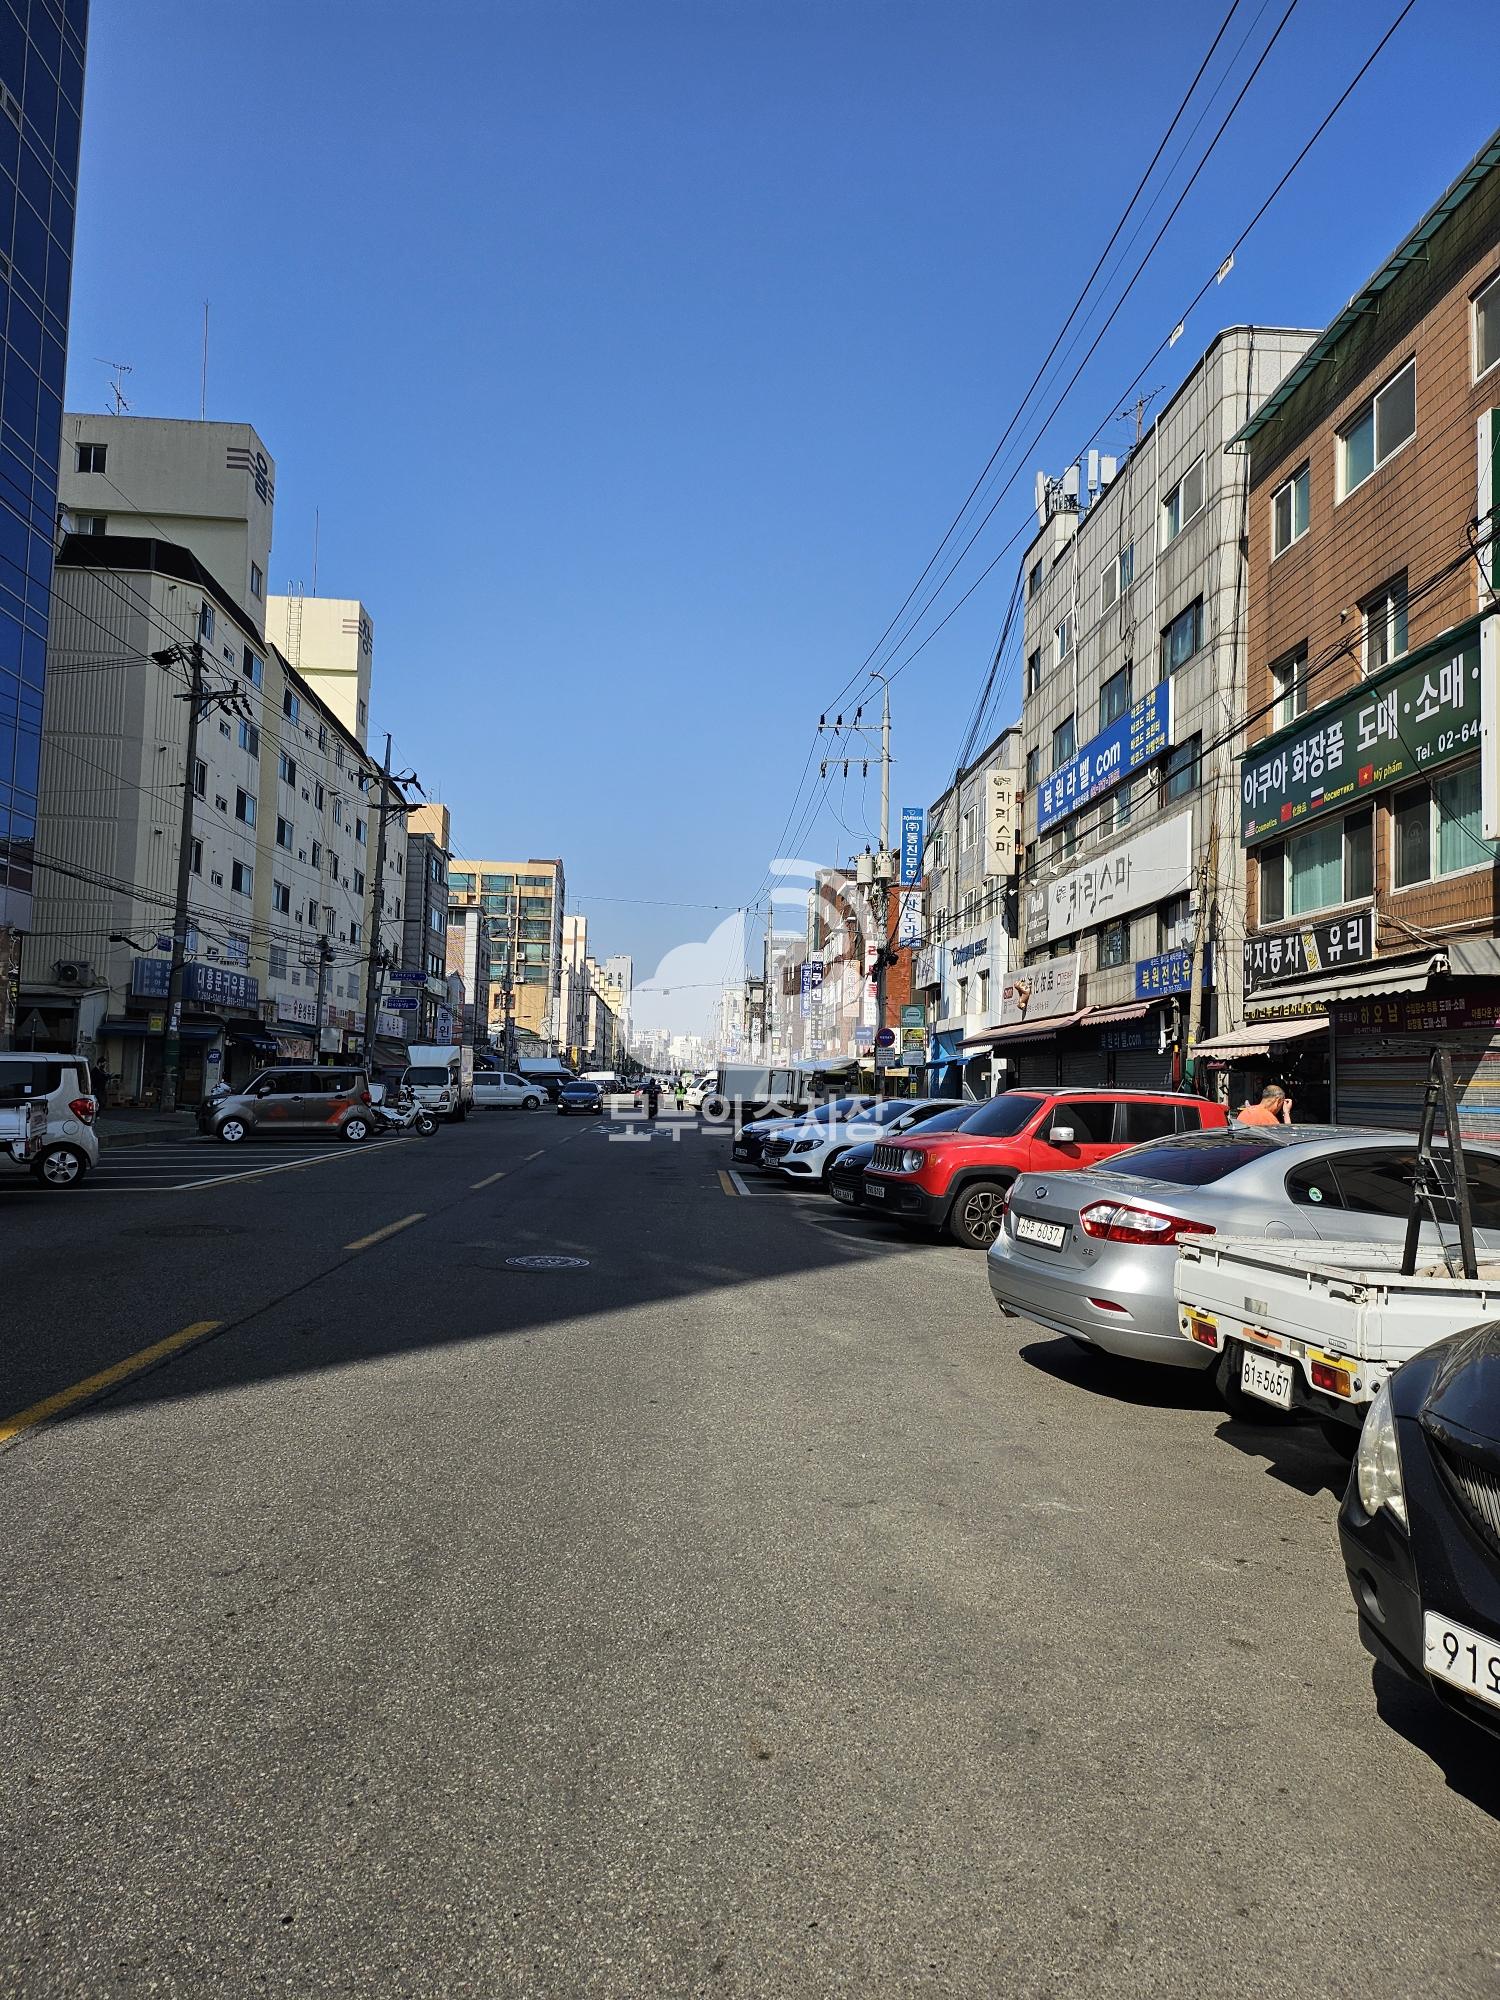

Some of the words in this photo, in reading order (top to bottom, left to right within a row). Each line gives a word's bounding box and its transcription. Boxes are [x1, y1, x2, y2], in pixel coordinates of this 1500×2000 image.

[1244, 752, 1288, 808] 아쿠아
[1292, 721, 1344, 783] 화장품
[1416, 742, 1434, 761] Tel.
[1324, 782, 1355, 803] Косметика
[995, 791, 1012, 856] 카리스마
[1255, 819, 1278, 834] Cosmetics
[1067, 853, 1133, 925] 카리스마
[1327, 918, 1364, 962] 유리
[1142, 959, 1191, 990] 북원전산유
[1037, 1224, 1060, 1242] 6037
[1082, 1248, 1095, 1256] SE
